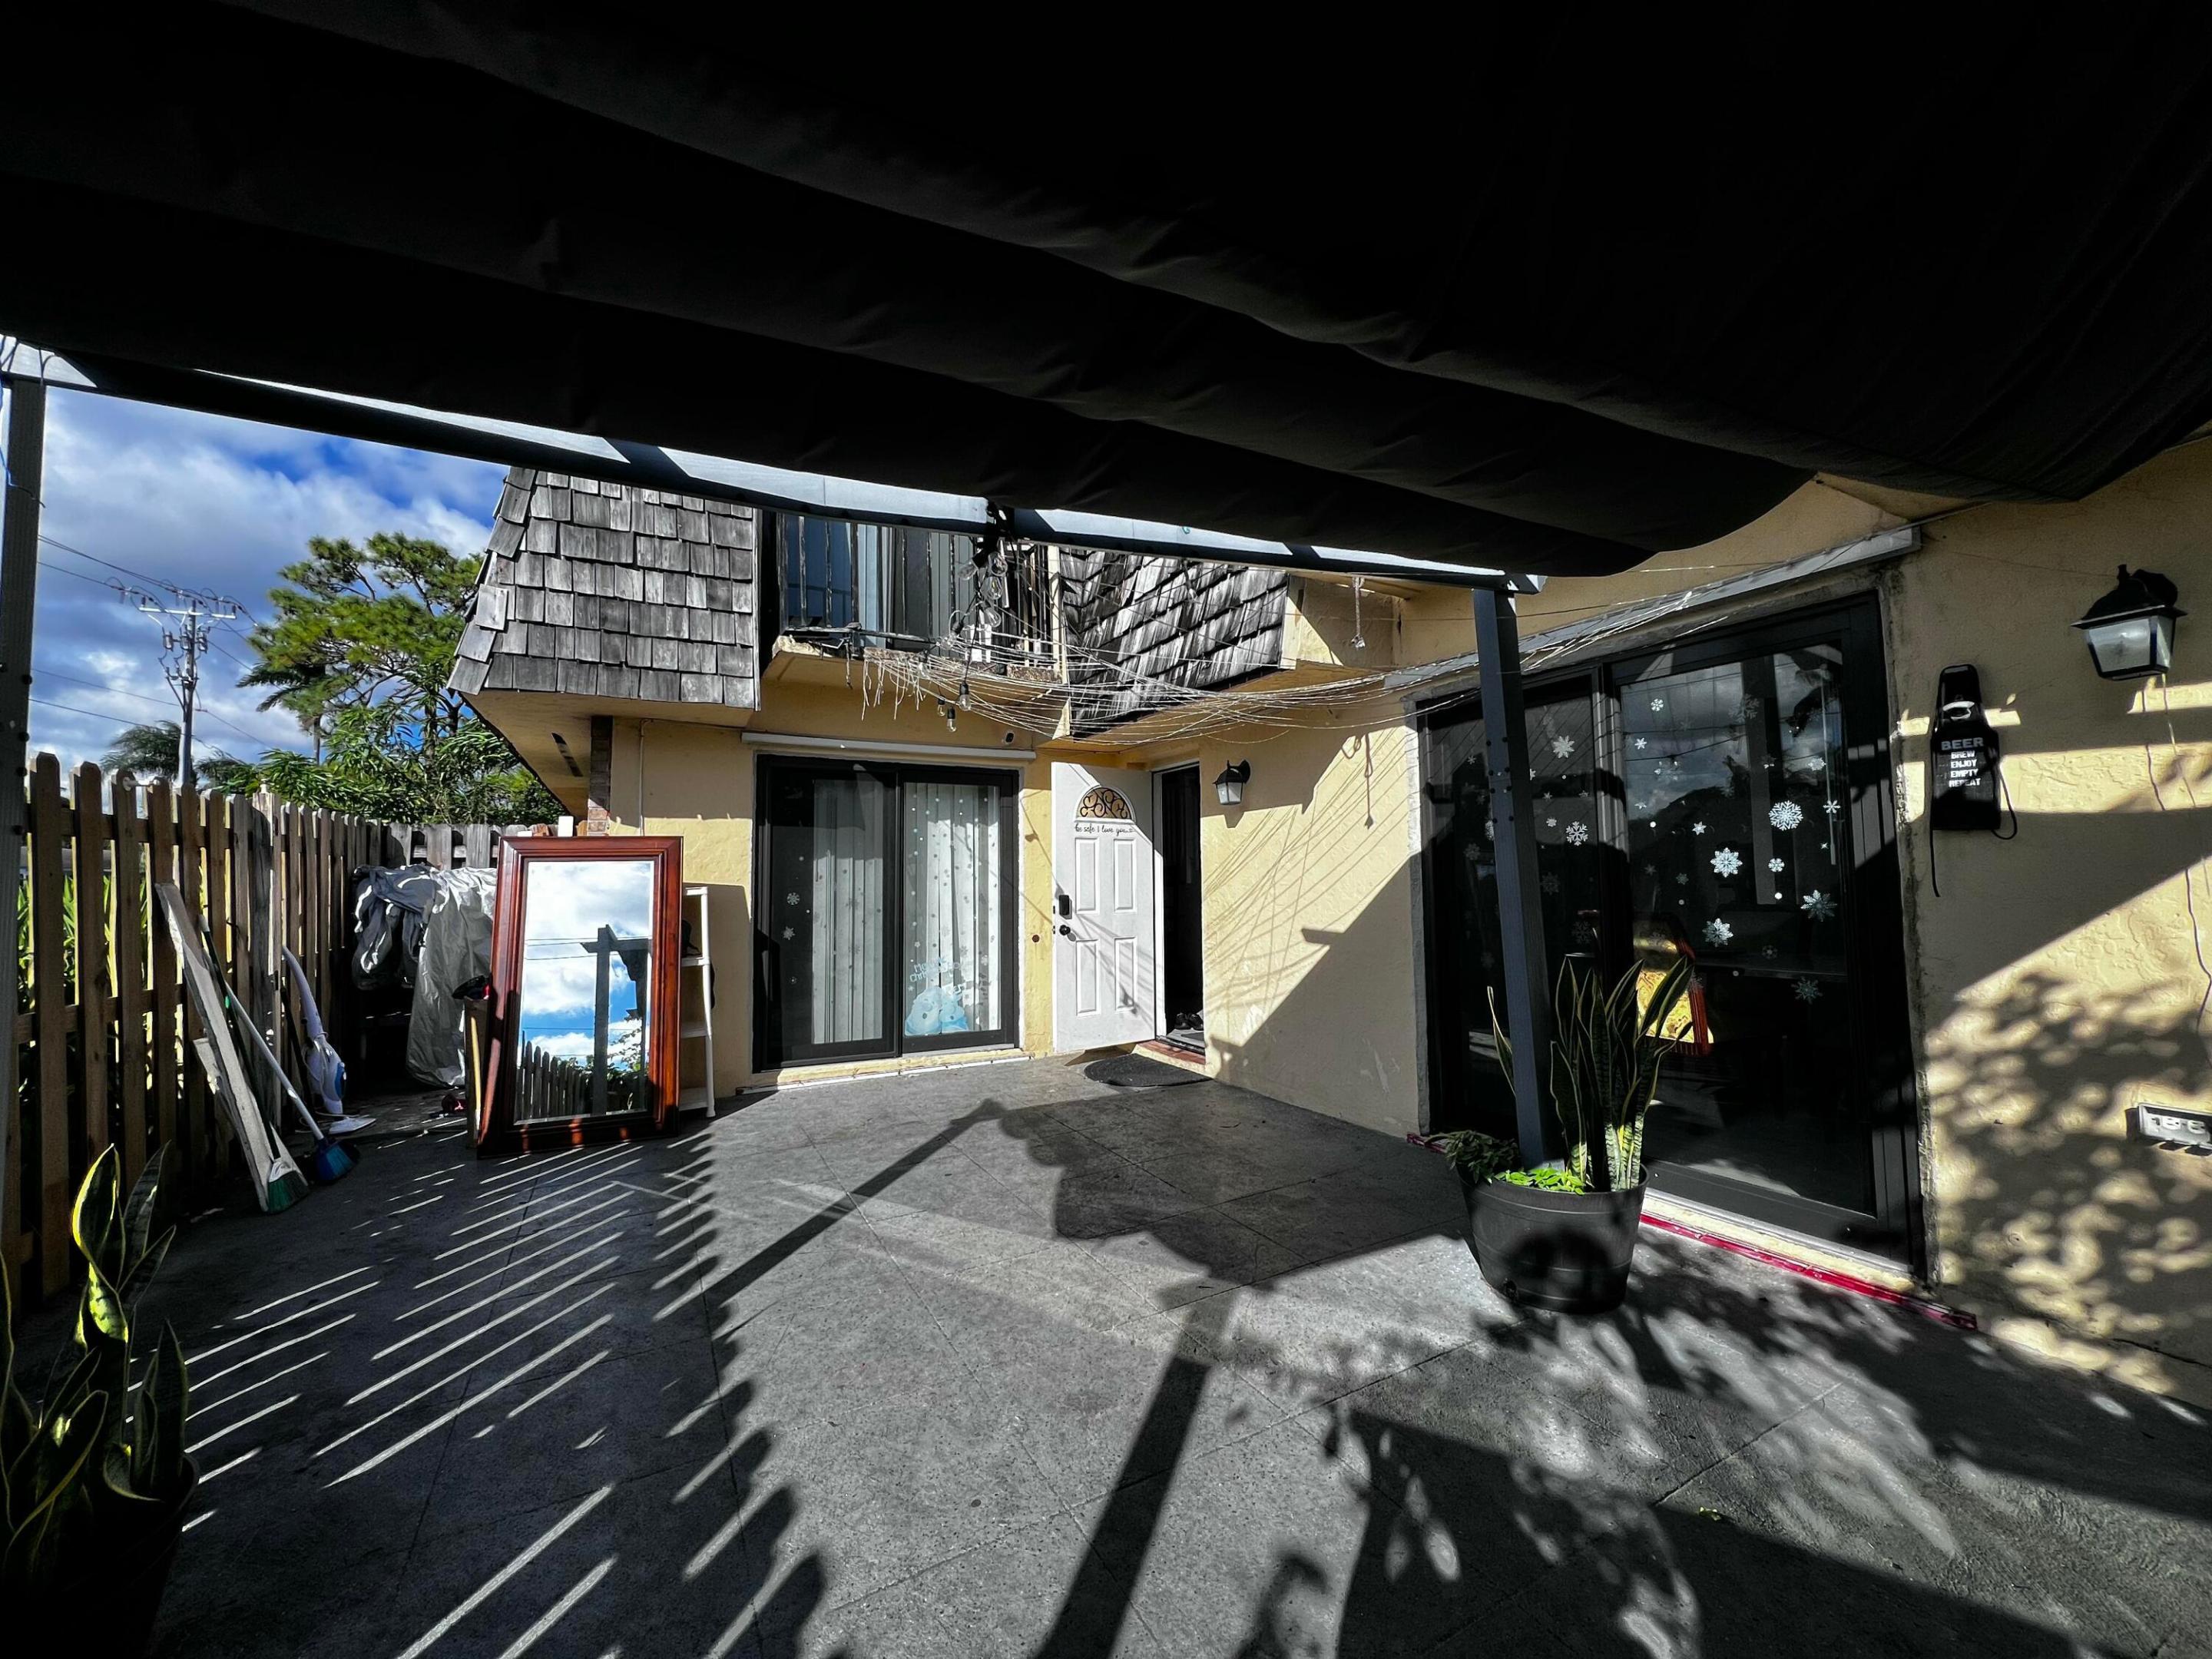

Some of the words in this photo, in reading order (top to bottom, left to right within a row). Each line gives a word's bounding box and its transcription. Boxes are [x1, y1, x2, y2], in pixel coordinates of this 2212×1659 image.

[1941, 737, 1984, 750] BEER
[1951, 750, 1975, 760] BREW
[1951, 759, 1978, 769] ENJOY
[1951, 768, 1979, 778] EMPTY
[1949, 778, 1981, 788] REPEAT
[1083, 823, 1095, 833] safe
[1101, 824, 1114, 833] love
